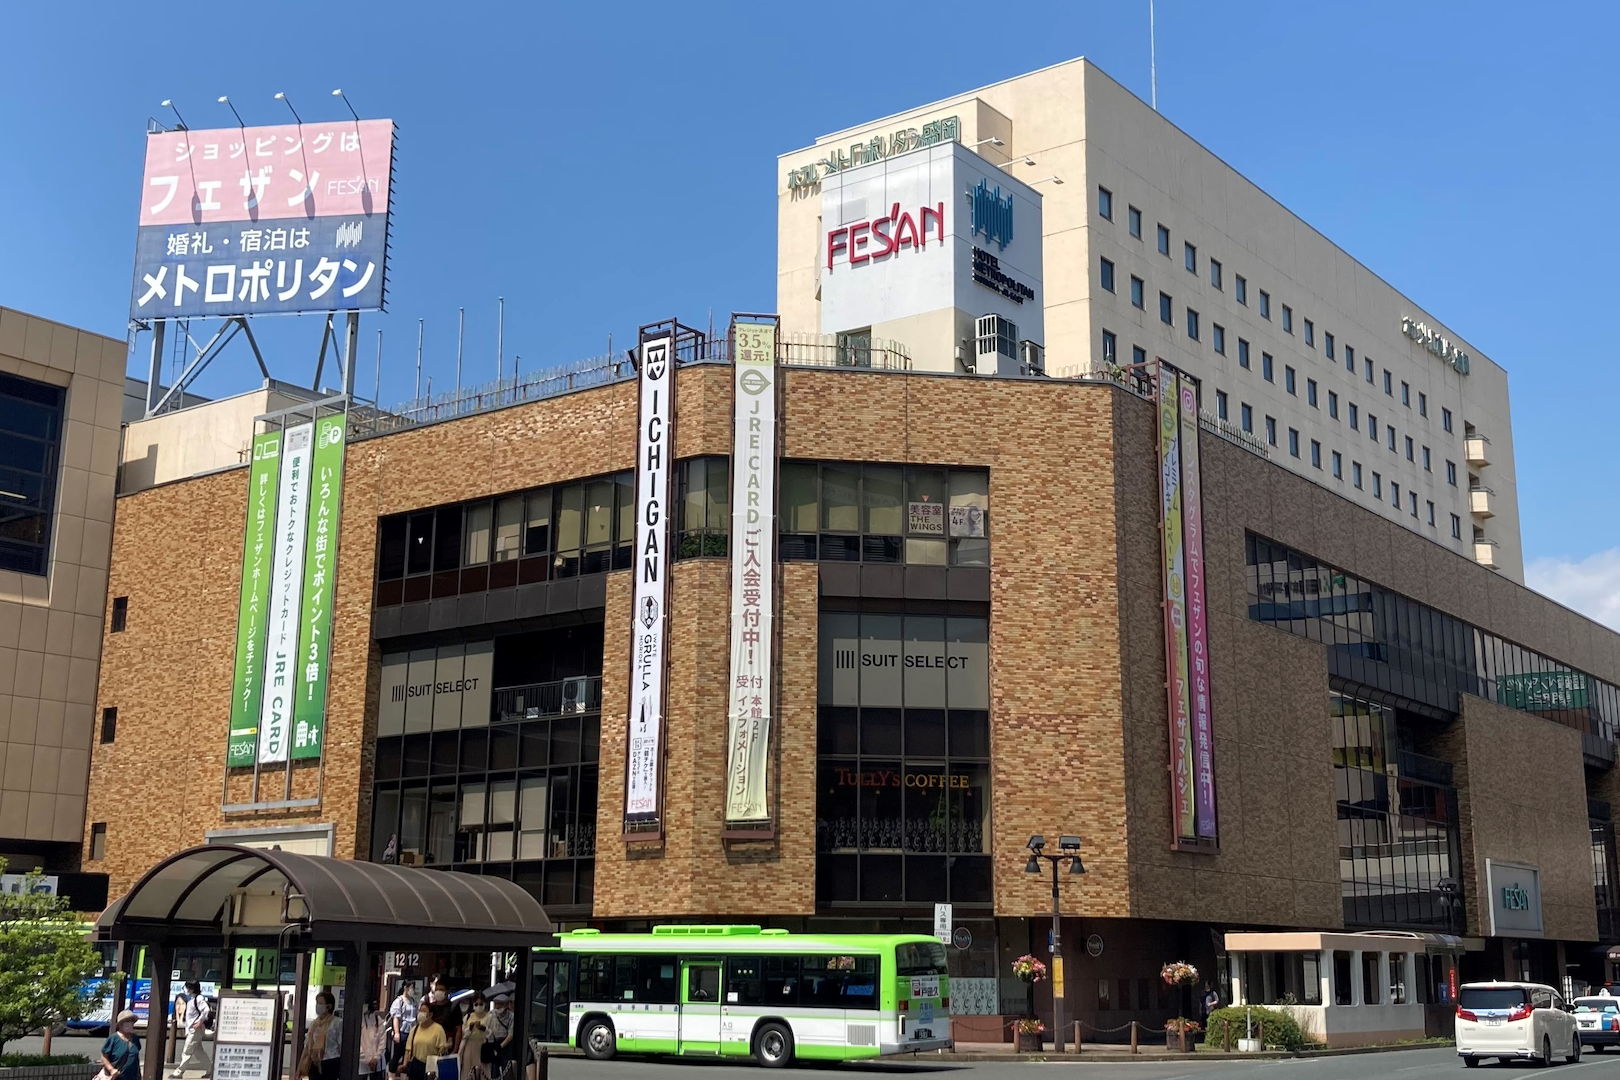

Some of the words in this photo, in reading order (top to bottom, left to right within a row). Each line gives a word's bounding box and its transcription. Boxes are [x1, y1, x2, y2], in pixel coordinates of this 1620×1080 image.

[175, 131, 361, 162] ショッピングは
[150, 165, 320, 215] フェザン
[166, 228, 310, 256] 婚礼・宿泊は
[973, 245, 1000, 271] HOTEL
[137, 256, 376, 308] メトロポリタン
[644, 389, 661, 584] ICHIGAN
[910, 504, 942, 516] 美容室
[911, 515, 931, 523] THE
[910, 522, 943, 531] WINGS
[274, 651, 288, 688] JRE
[642, 634, 652, 691] GRULLA
[861, 653, 899, 668] SUIT
[904, 654, 969, 669] SELECT
[408, 683, 433, 698] SUIT
[436, 677, 479, 695] SELECT
[269, 696, 284, 755] CARD
[904, 773, 970, 789] COFFEE
[237, 954, 252, 974] 11
[258, 954, 275, 974] 11
[395, 953, 406, 967] 12
[408, 953, 420, 967] 12
